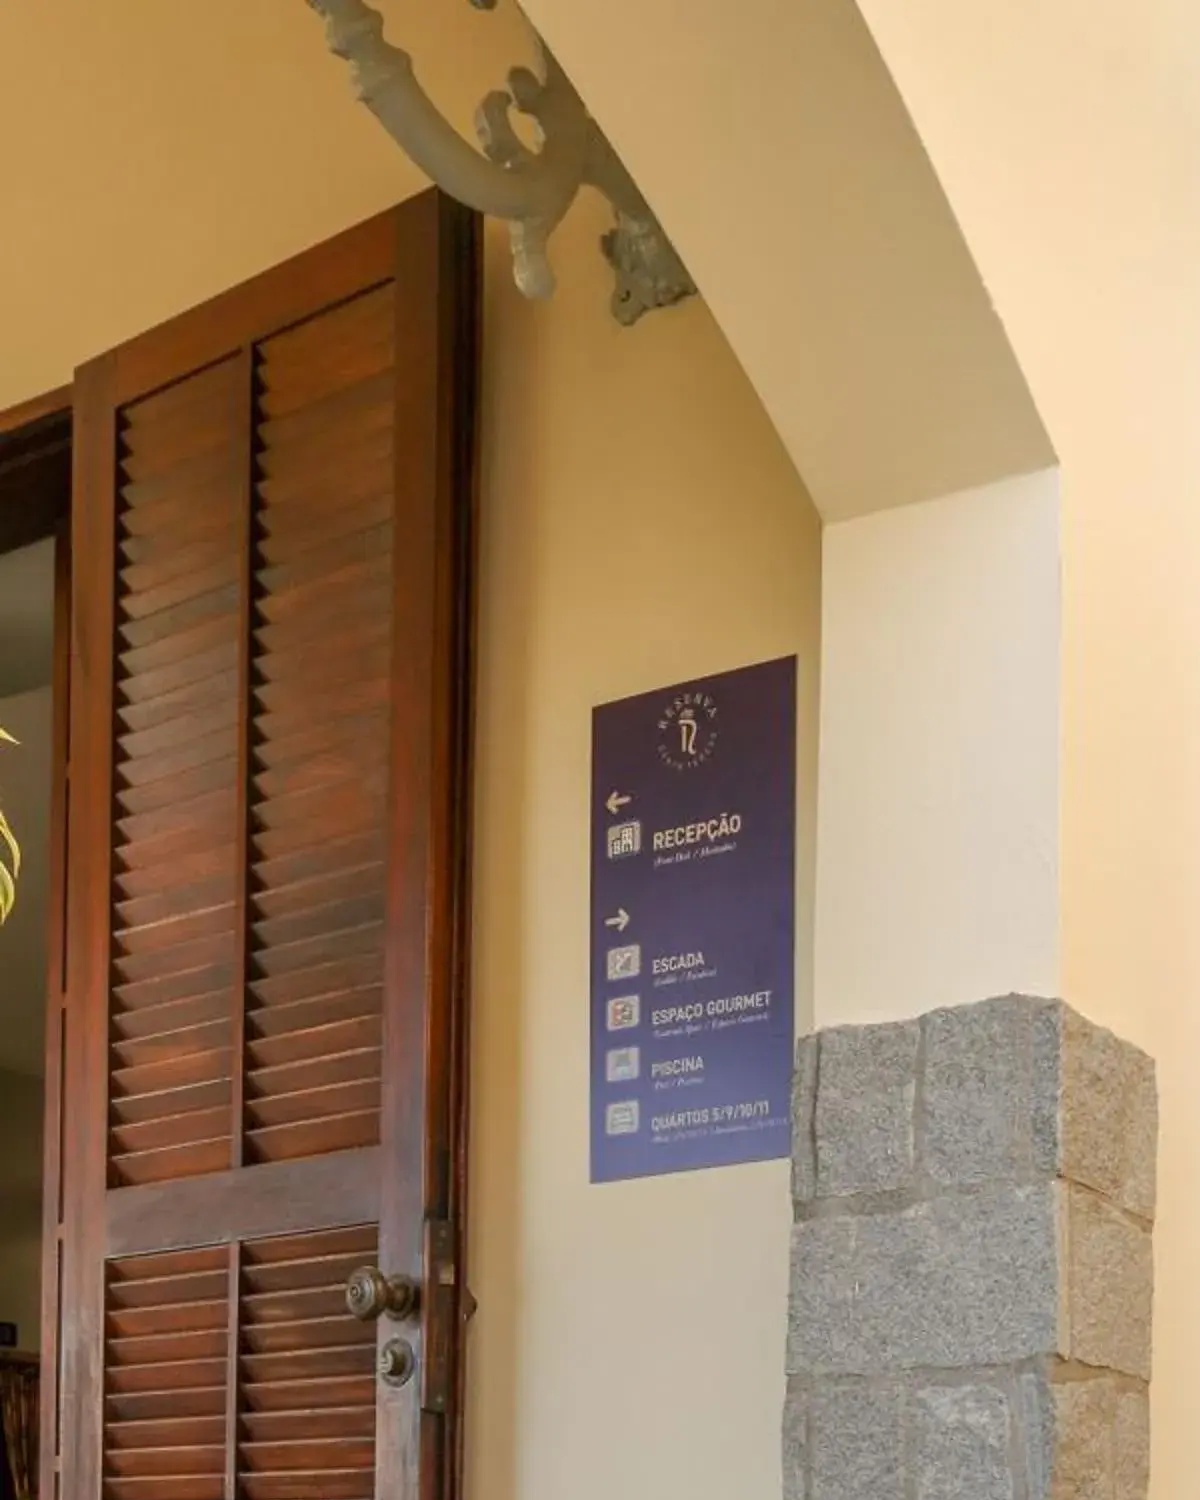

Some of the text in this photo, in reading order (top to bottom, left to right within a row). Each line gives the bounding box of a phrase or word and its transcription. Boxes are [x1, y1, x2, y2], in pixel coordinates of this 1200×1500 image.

[653, 812, 742, 850] RECEPÇÃO
[652, 951, 705, 974] ESCADA
[651, 1003, 703, 1025] ESPAÇO
[706, 990, 772, 1015] GOURMET
[651, 1055, 704, 1079] PISCINA
[651, 1107, 709, 1132] QUARTOS
